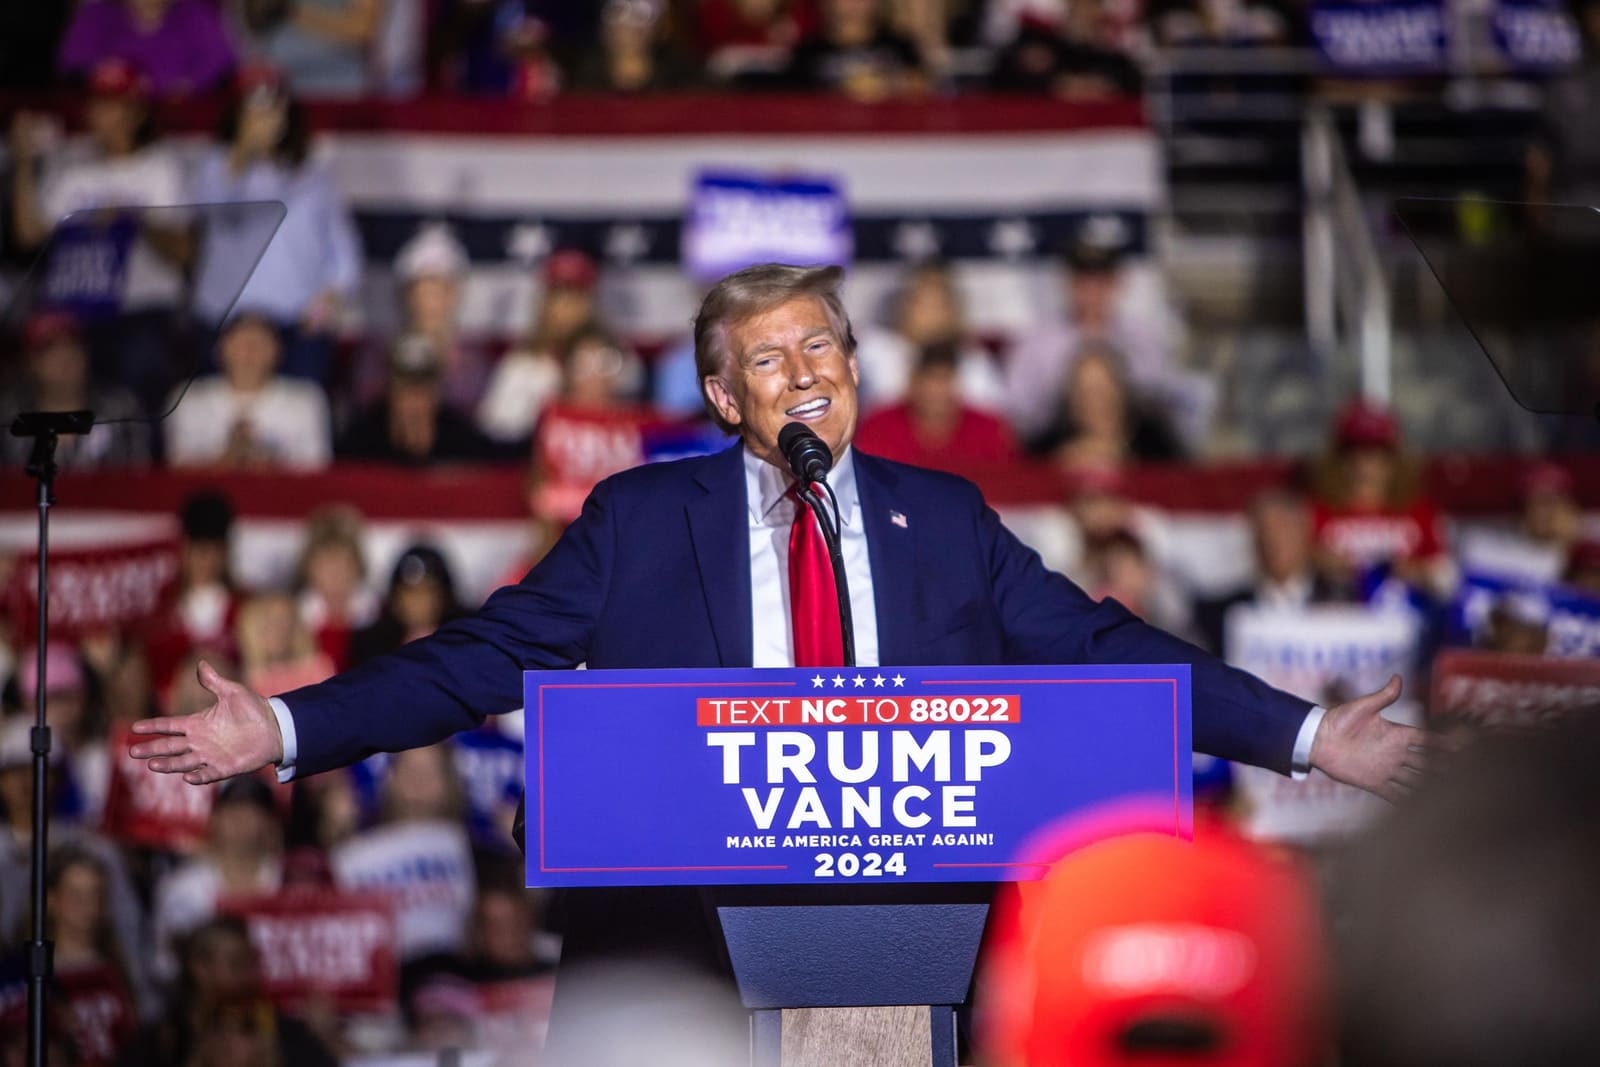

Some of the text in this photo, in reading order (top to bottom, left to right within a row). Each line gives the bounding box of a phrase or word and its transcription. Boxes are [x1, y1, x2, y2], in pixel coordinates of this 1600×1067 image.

[708, 697, 1009, 725] TEXT NC TO 88022
[706, 729, 1012, 785] TRUMP
[741, 785, 977, 830] VANCE
[726, 833, 994, 849] MAKE AMERICA GREAT AGAIN!
[814, 852, 907, 877] 2024
